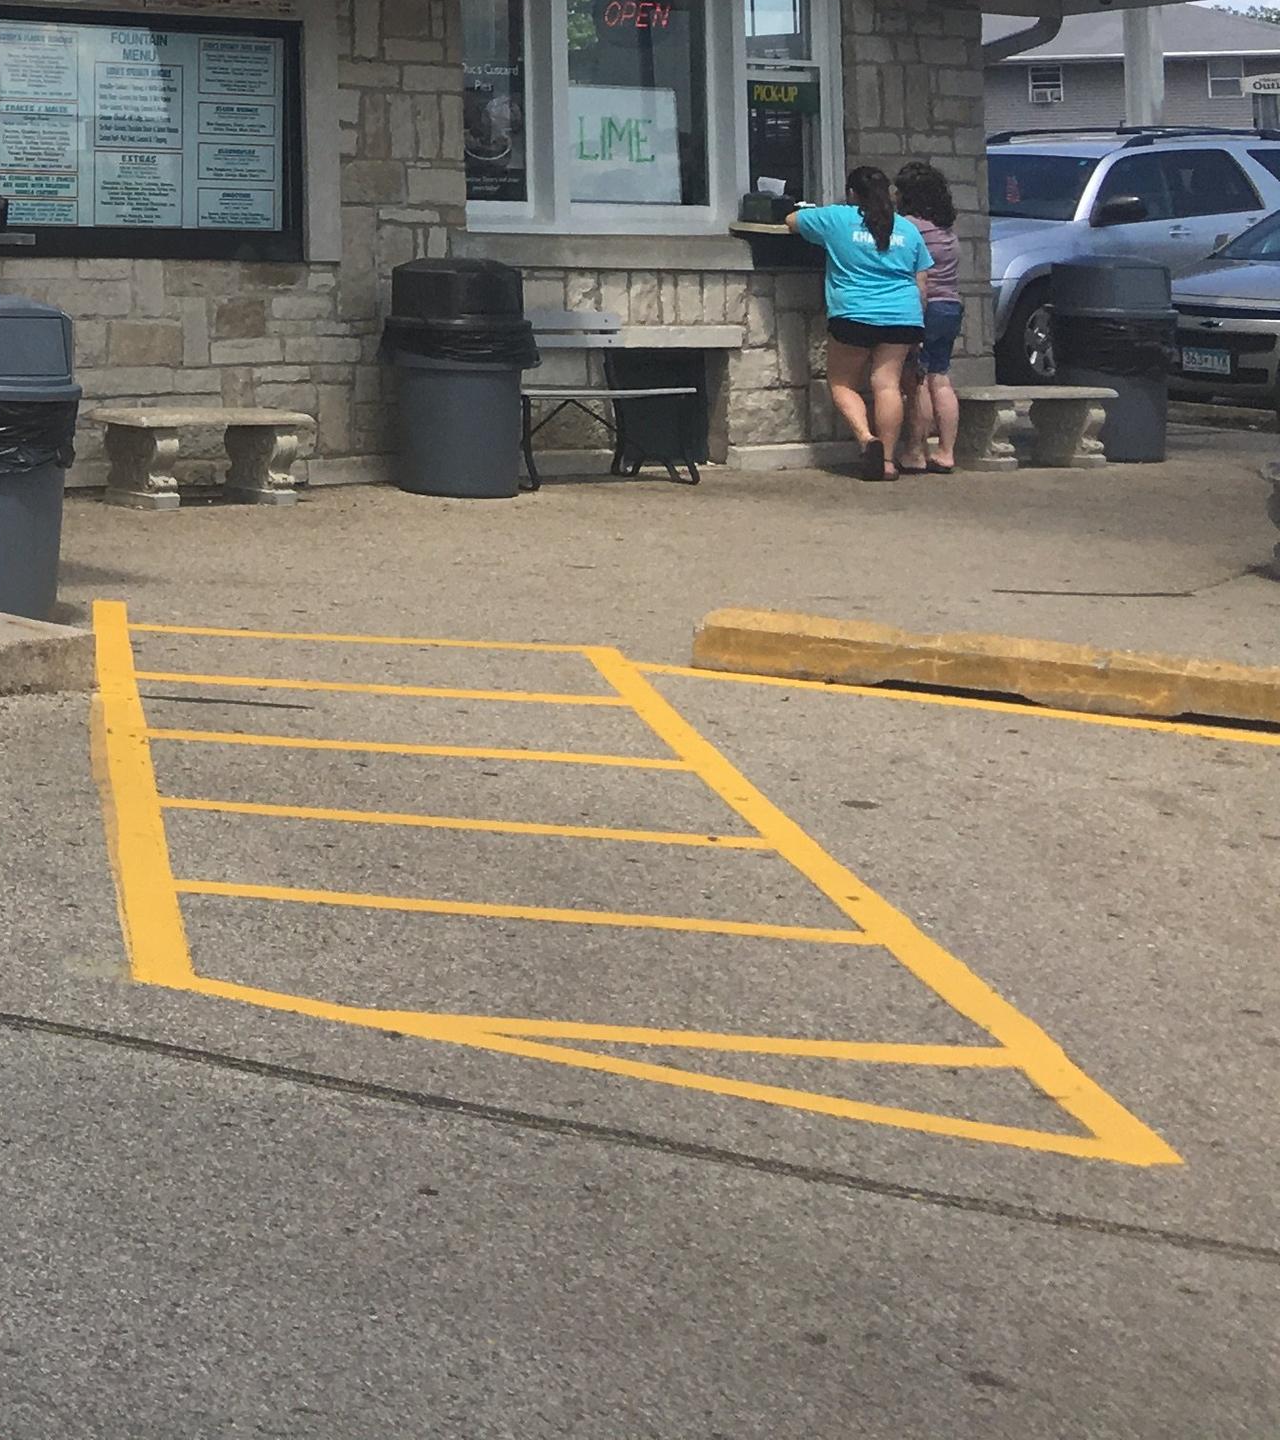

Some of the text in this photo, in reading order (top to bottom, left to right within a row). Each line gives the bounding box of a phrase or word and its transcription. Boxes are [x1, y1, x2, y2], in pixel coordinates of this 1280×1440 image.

[603, 0, 673, 30] OPEN
[110, 31, 168, 47] FOUNTAIN
[122, 48, 157, 62] MENU
[753, 84, 798, 103] PICK-UP
[577, 115, 656, 163] LIME
[121, 154, 157, 164] EXTRAS
